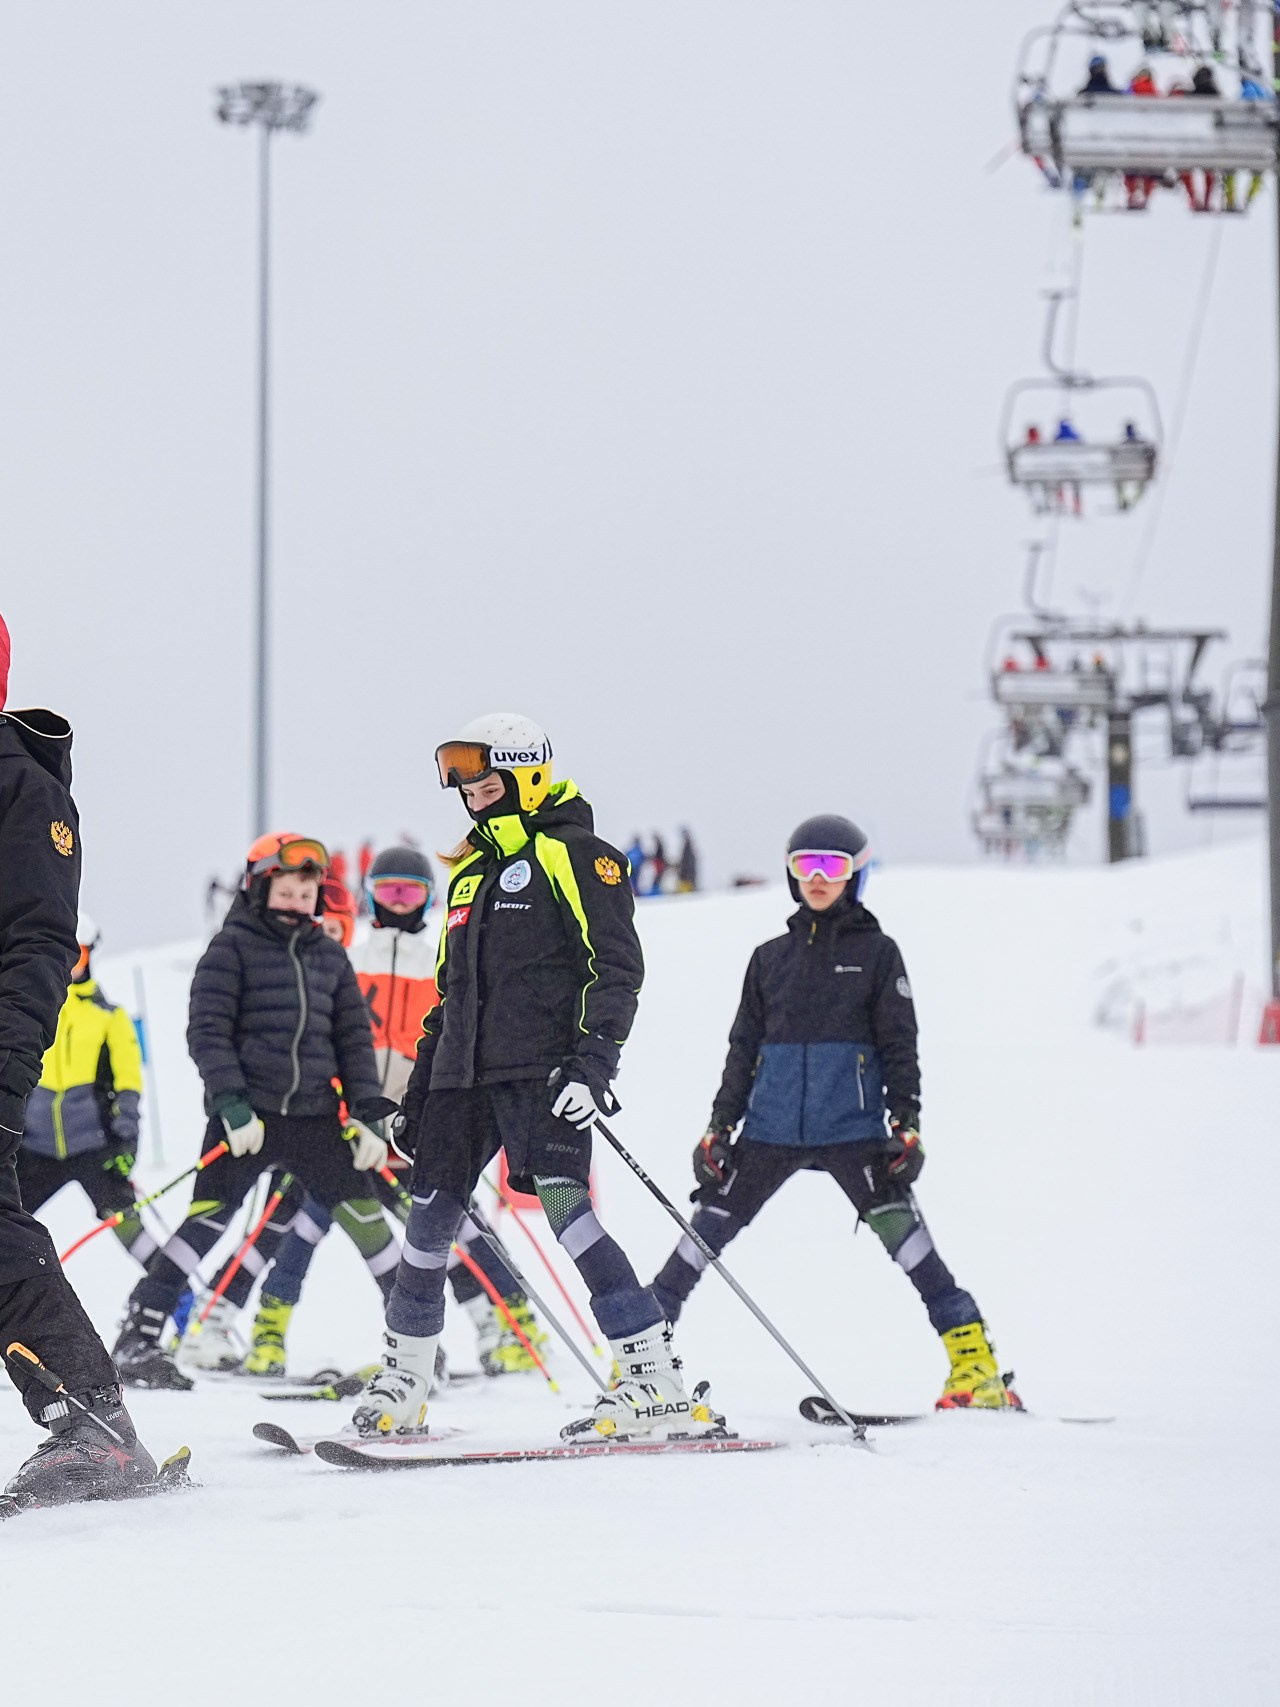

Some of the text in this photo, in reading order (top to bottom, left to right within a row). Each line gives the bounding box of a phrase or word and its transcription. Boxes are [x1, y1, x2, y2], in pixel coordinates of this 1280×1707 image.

[493, 751, 540, 763] uvex
[498, 902, 531, 910] SCOTT
[635, 1402, 689, 1419] HEAD
